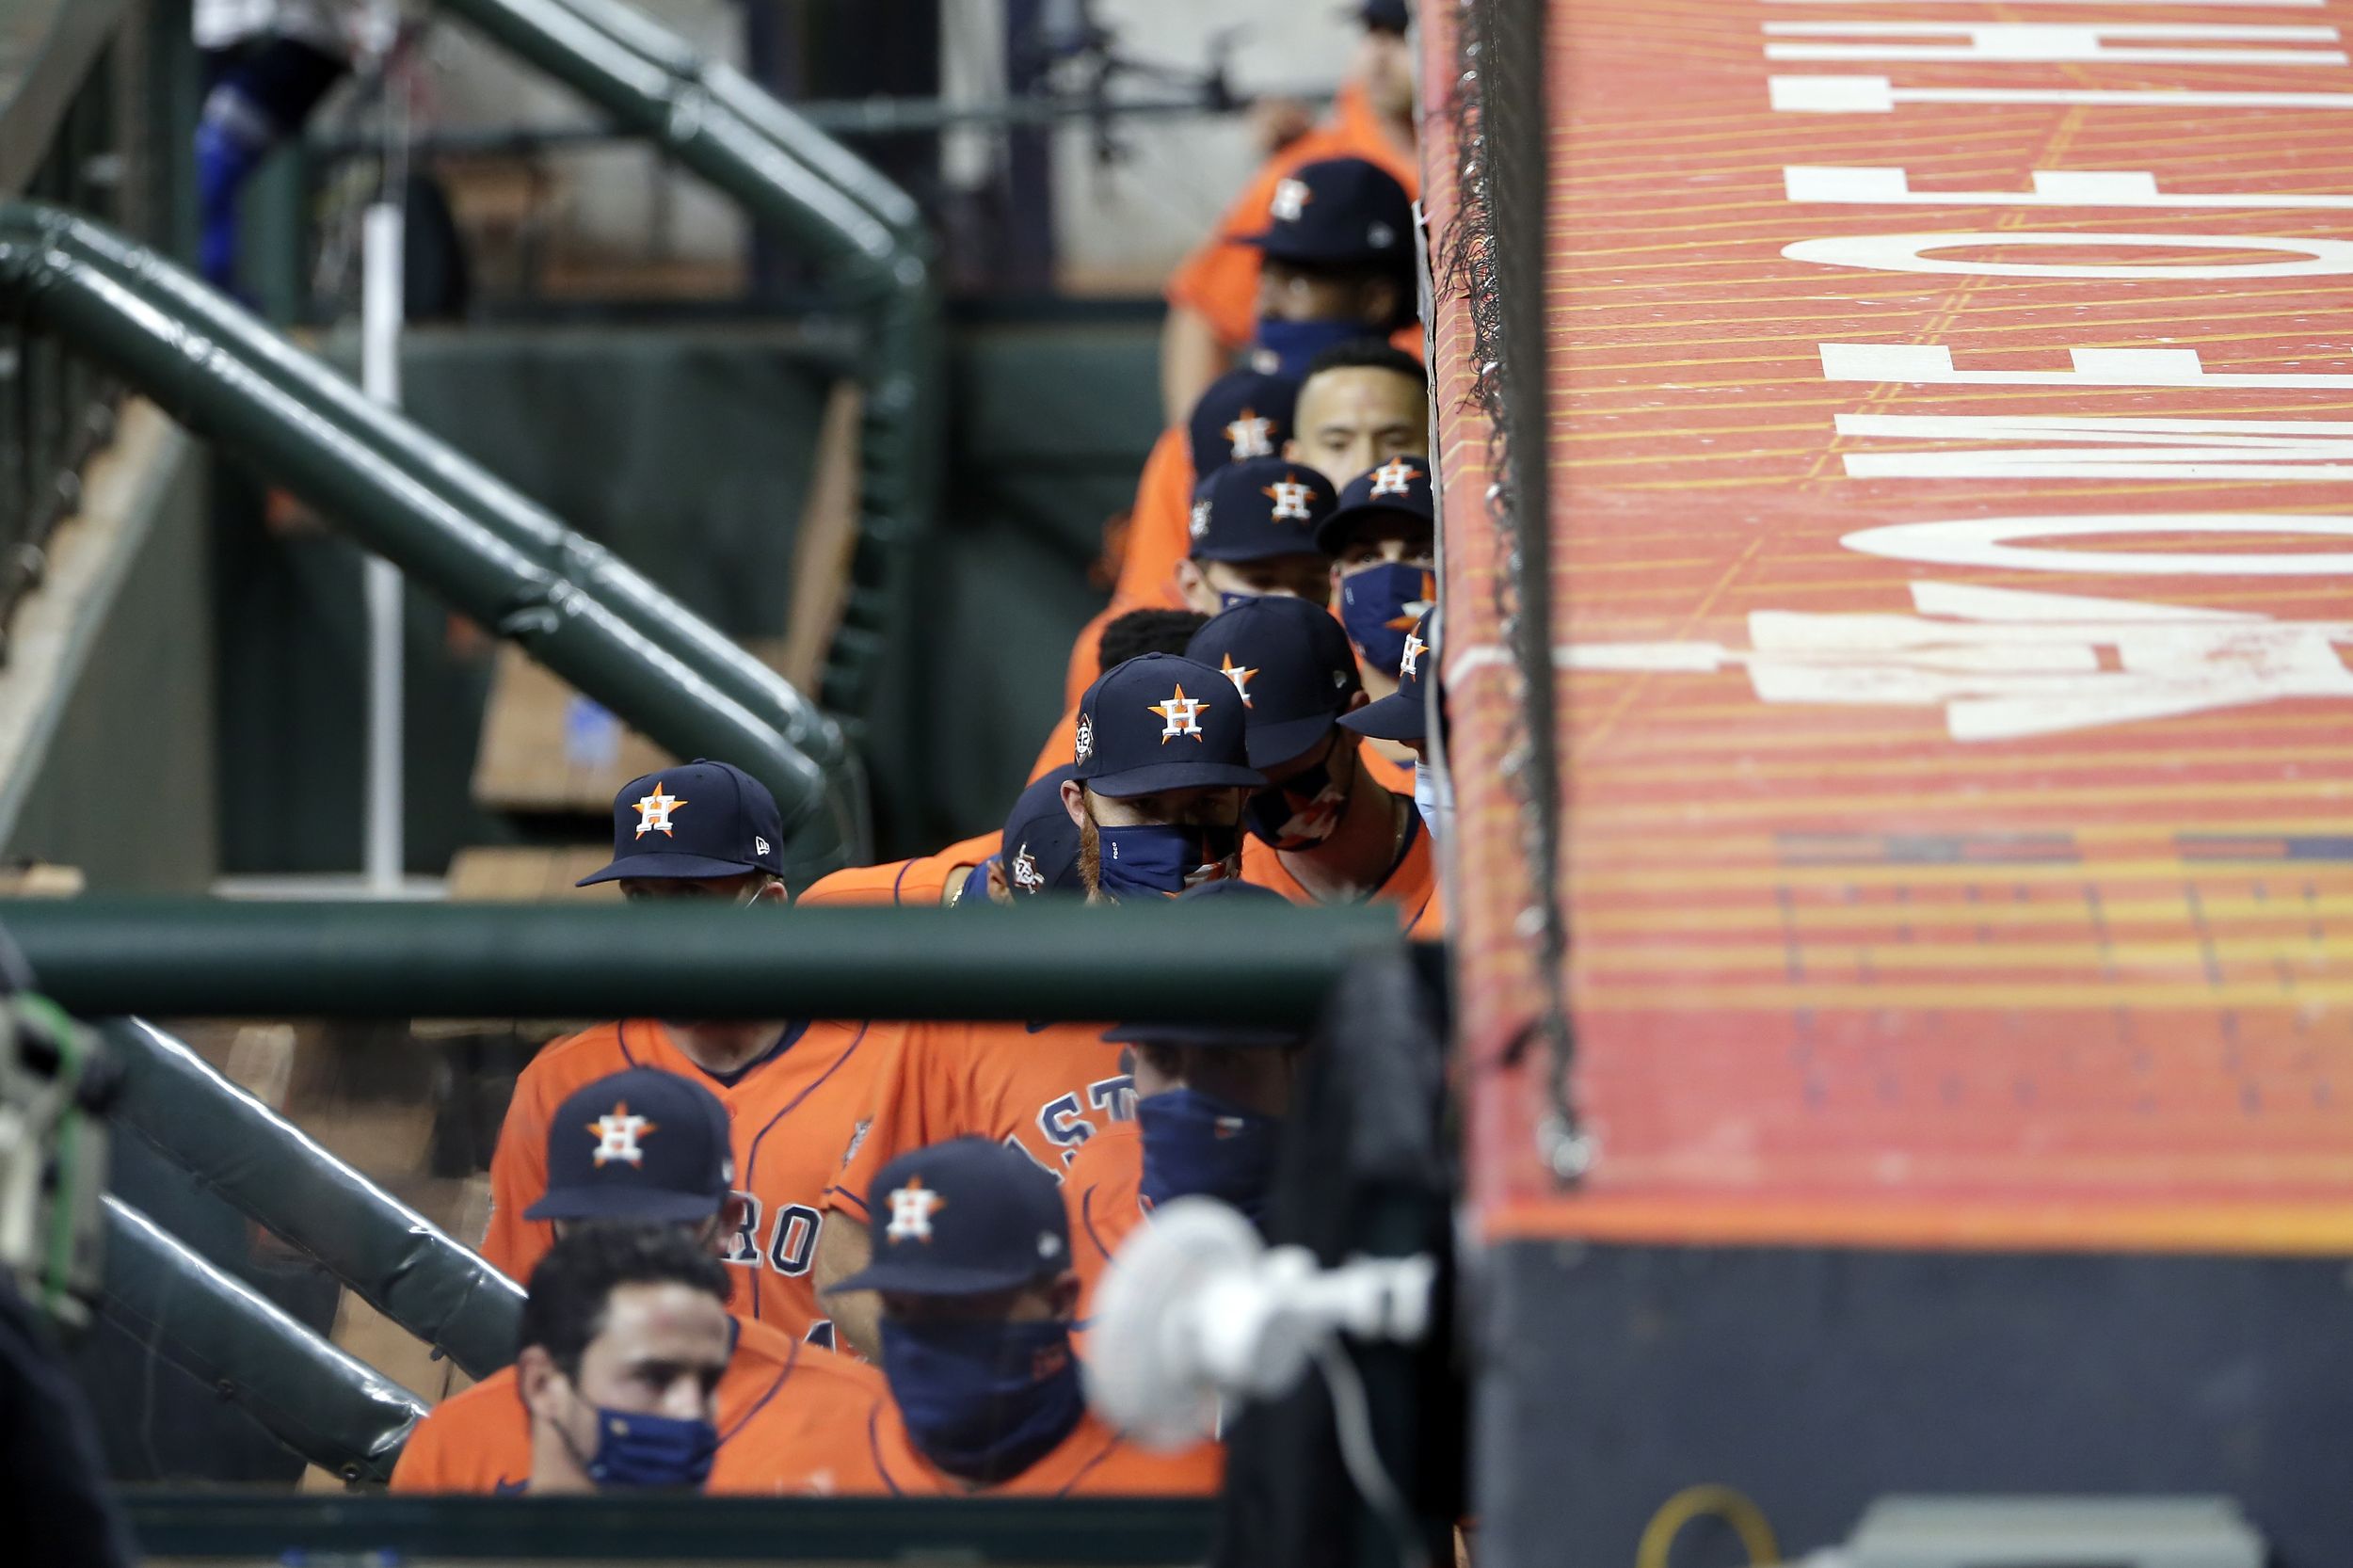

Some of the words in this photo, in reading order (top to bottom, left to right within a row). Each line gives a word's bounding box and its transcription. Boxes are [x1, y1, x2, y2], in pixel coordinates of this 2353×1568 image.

[1759, 0, 2353, 113] TH
[1780, 166, 2353, 279] OF
[1271, 480, 1312, 520] H
[1369, 462, 1415, 496] H
[1159, 696, 1205, 739] H
[634, 793, 678, 833] H
[592, 1113, 648, 1162] H
